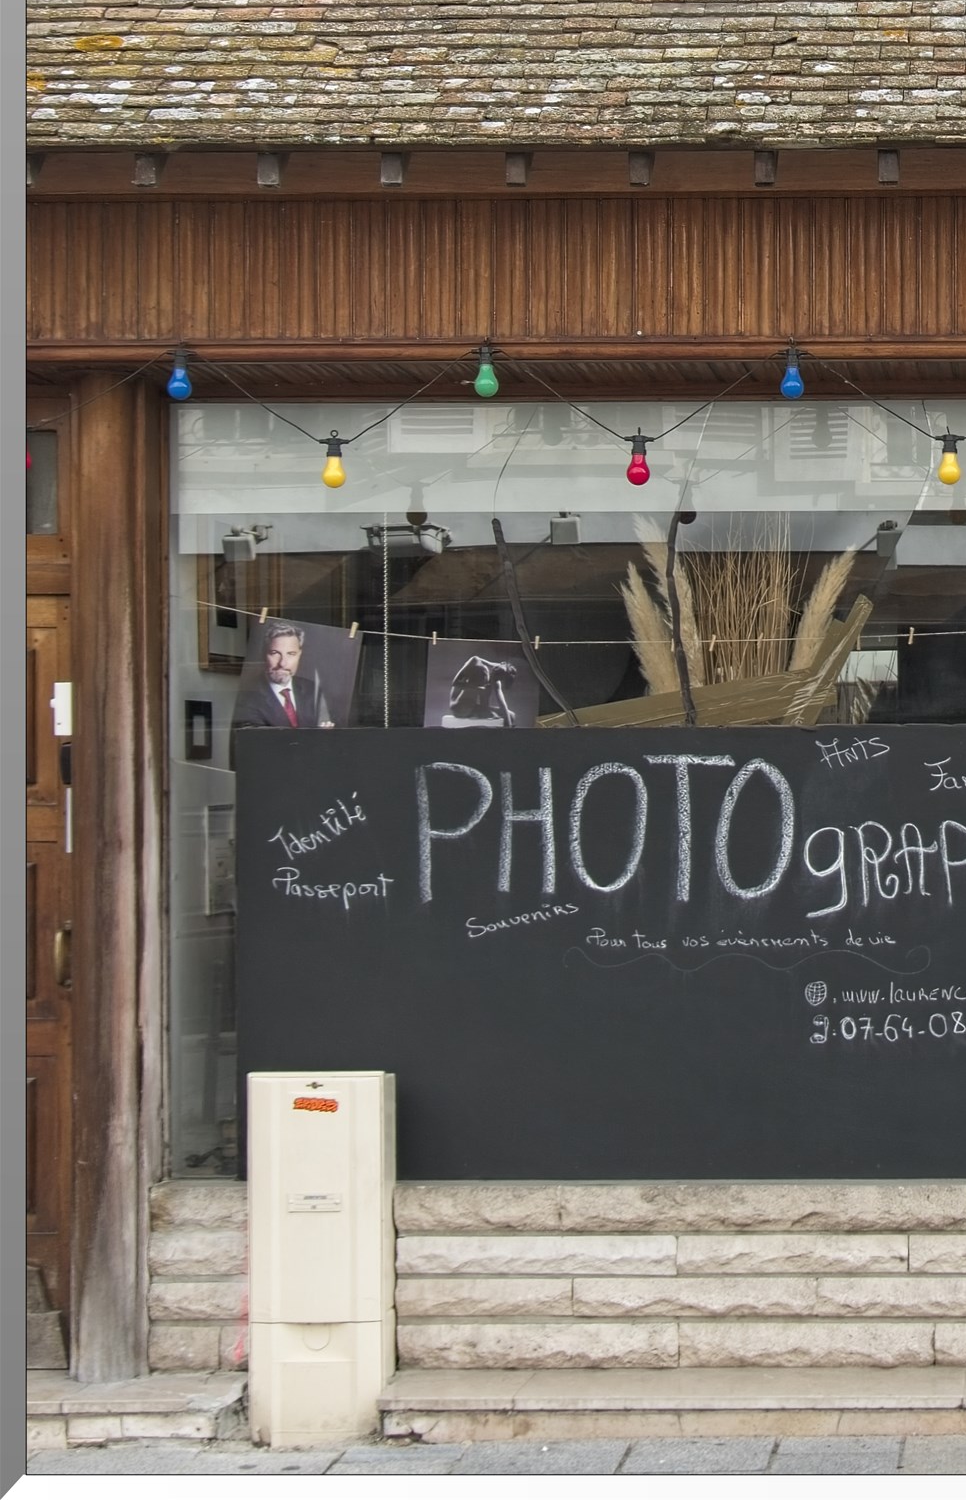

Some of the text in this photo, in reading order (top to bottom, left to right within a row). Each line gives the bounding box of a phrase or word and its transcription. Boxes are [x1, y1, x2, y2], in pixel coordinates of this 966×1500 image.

[267, 790, 367, 860] Identité
[271, 866, 394, 910] Passeport
[586, 928, 627, 947] Pour
[632, 930, 668, 949] tous
[682, 934, 708, 947] vos
[845, 929, 866, 946] de
[867, 931, 897, 946] vie
